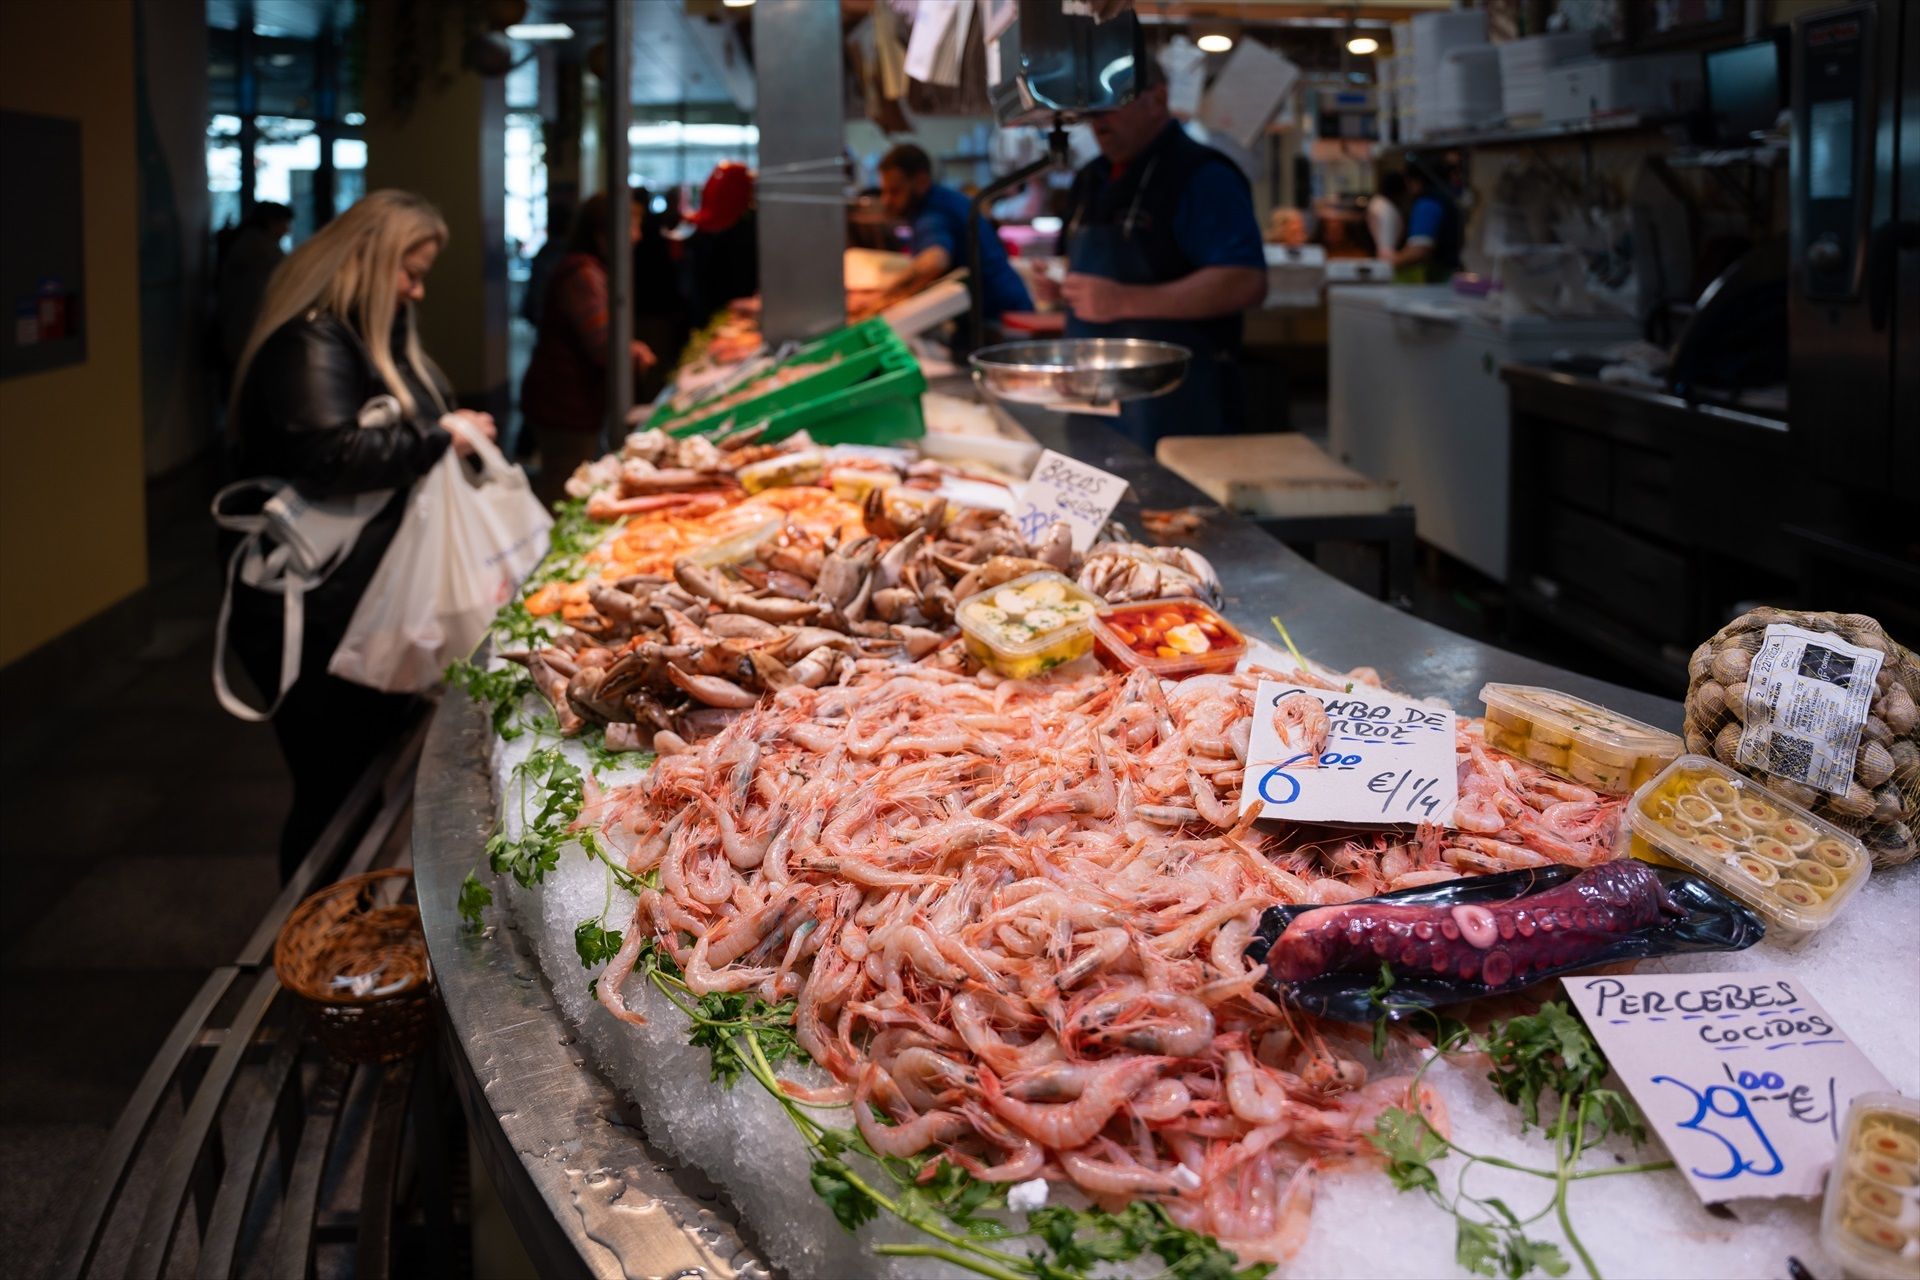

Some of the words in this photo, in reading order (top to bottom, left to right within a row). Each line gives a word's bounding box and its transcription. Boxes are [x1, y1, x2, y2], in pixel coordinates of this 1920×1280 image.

[1040, 459, 1107, 494] BOCAS
[1330, 721, 1415, 740] RROZ
[1399, 707, 1446, 726] DE
[1585, 978, 1797, 1016] PERCEBES
[1700, 1015, 1834, 1045] COCIDOS
